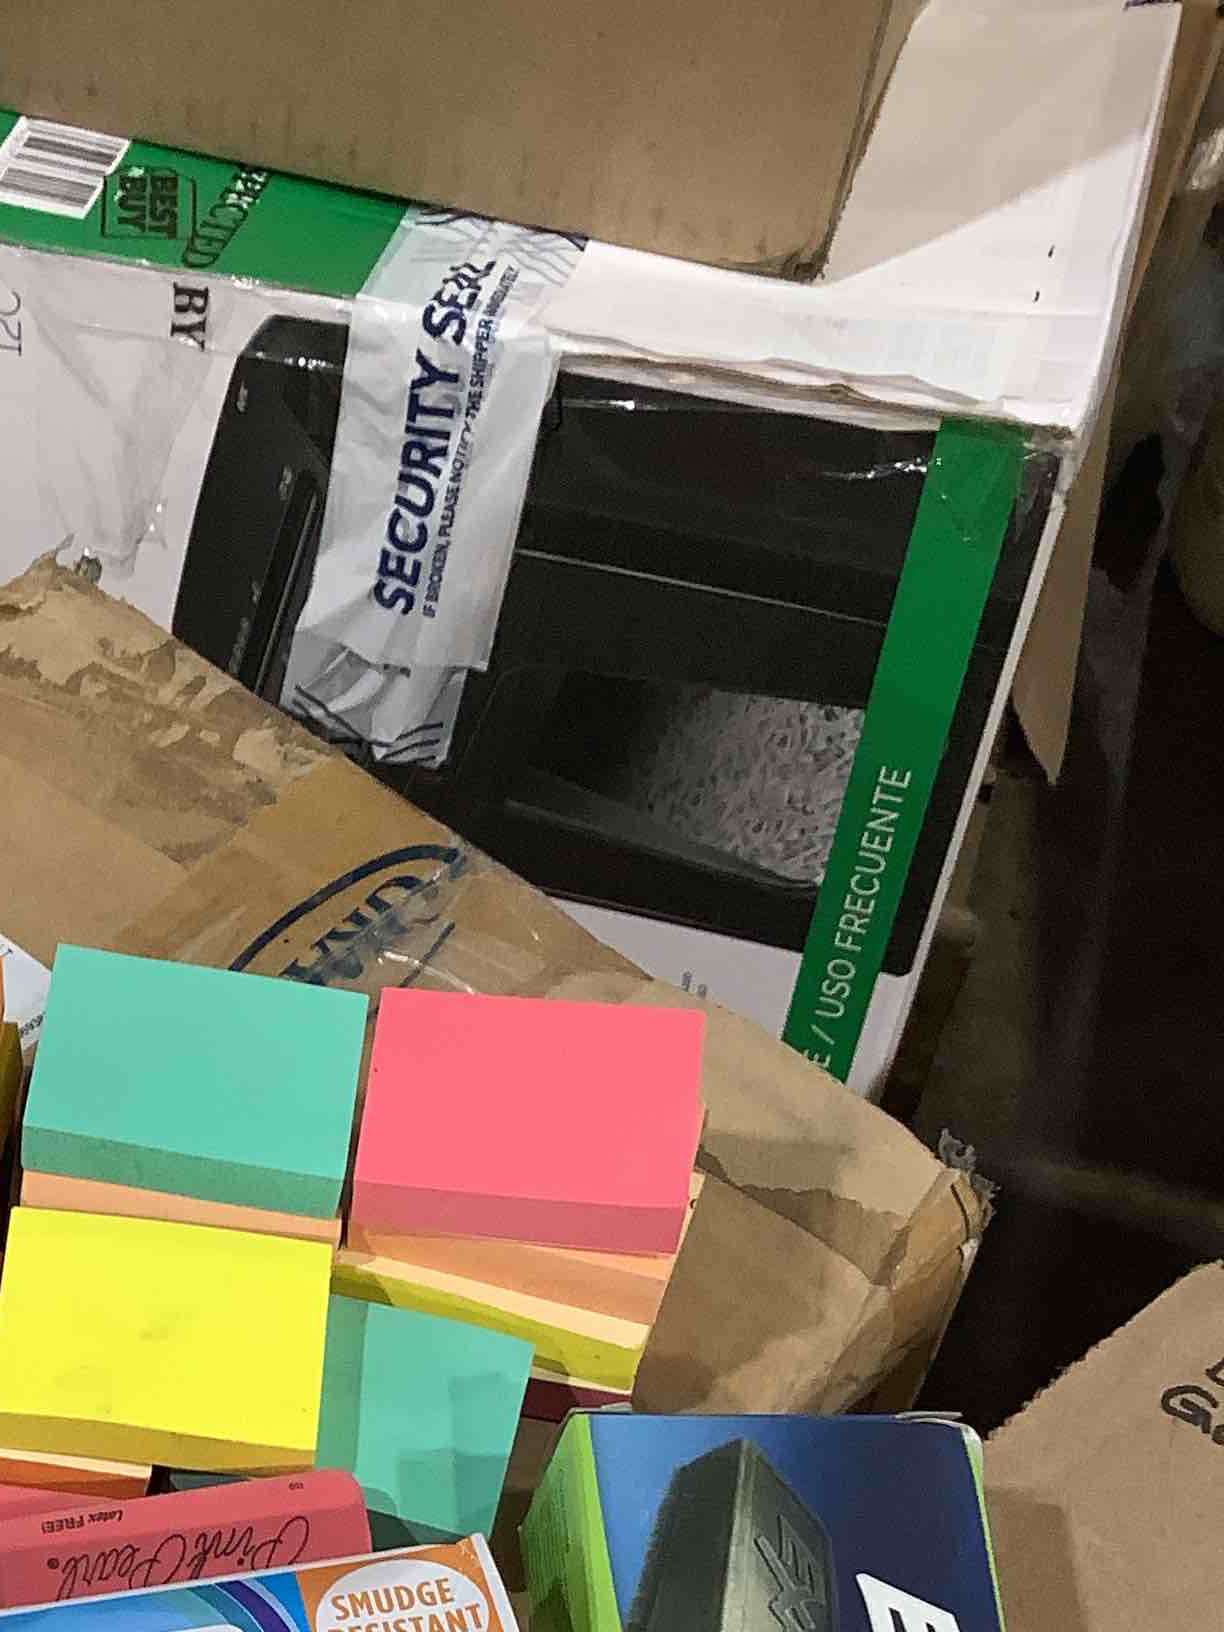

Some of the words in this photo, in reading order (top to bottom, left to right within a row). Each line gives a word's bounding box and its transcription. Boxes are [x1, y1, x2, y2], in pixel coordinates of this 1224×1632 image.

[169, 281, 210, 351] BY
[373, 347, 461, 615] SECURITY
[421, 261, 497, 346] SEAL
[438, 486, 461, 537] PLEASE
[468, 318, 494, 391] SHIPPER
[834, 765, 912, 953] FRECUENTE
[815, 958, 857, 1020] USO
[87, 1508, 125, 1525] Latex
[192, 1515, 311, 1578] Pink
[55, 1533, 188, 1601] Pearl
[331, 1577, 456, 1622] SMUDGE
